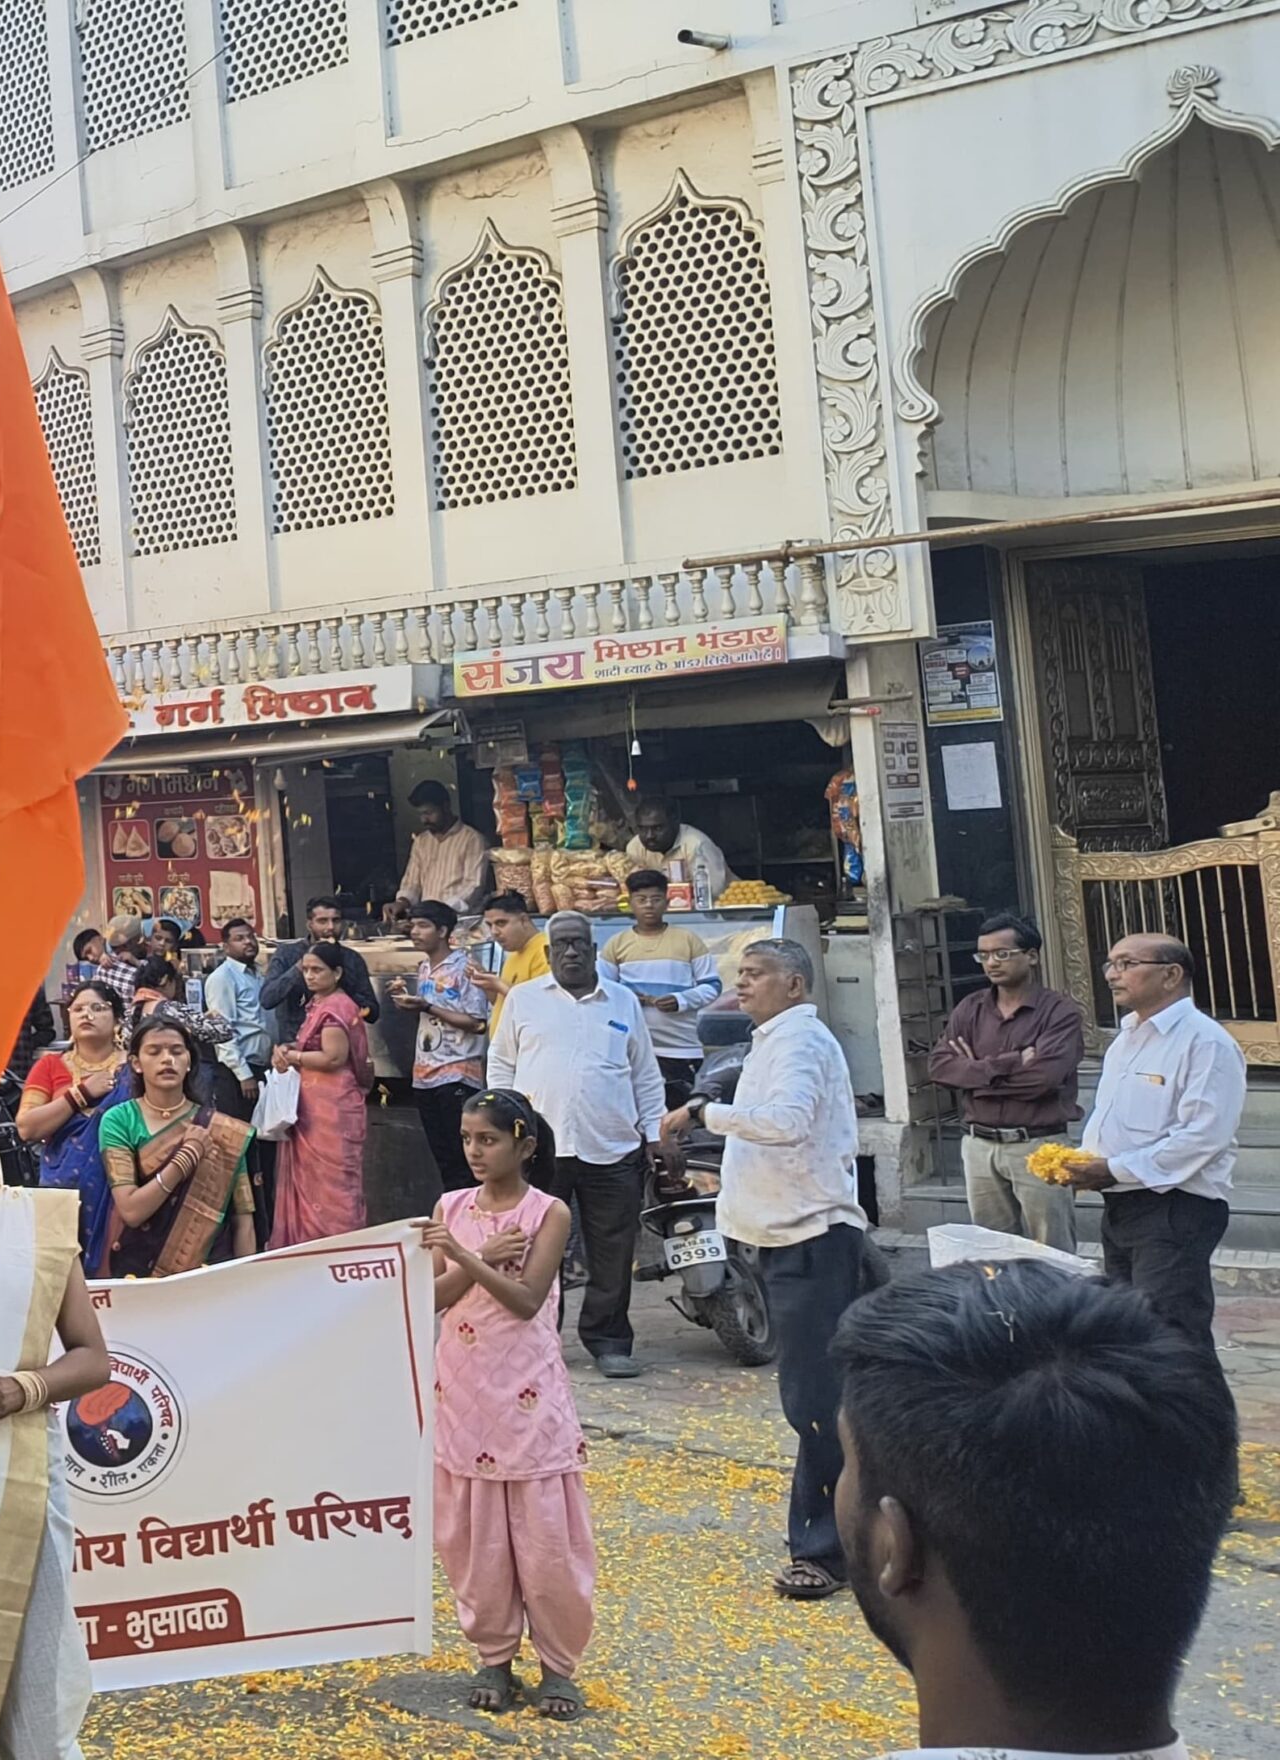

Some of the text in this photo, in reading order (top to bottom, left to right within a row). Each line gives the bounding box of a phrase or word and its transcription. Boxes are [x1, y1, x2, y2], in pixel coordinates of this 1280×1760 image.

[461, 650, 585, 690] संजय
[696, 626, 777, 650] भंडार
[655, 660, 668, 671] के
[154, 689, 225, 726] गर्ग
[327, 1258, 397, 1284] एकता
[671, 1246, 720, 1265] 0399
[99, 1470, 129, 1489] शील
[137, 1443, 167, 1473] एकता
[137, 1498, 276, 1564] विद्यार्थी
[286, 1492, 413, 1541] परिषद
[127, 1598, 230, 1650] भुसावळ
